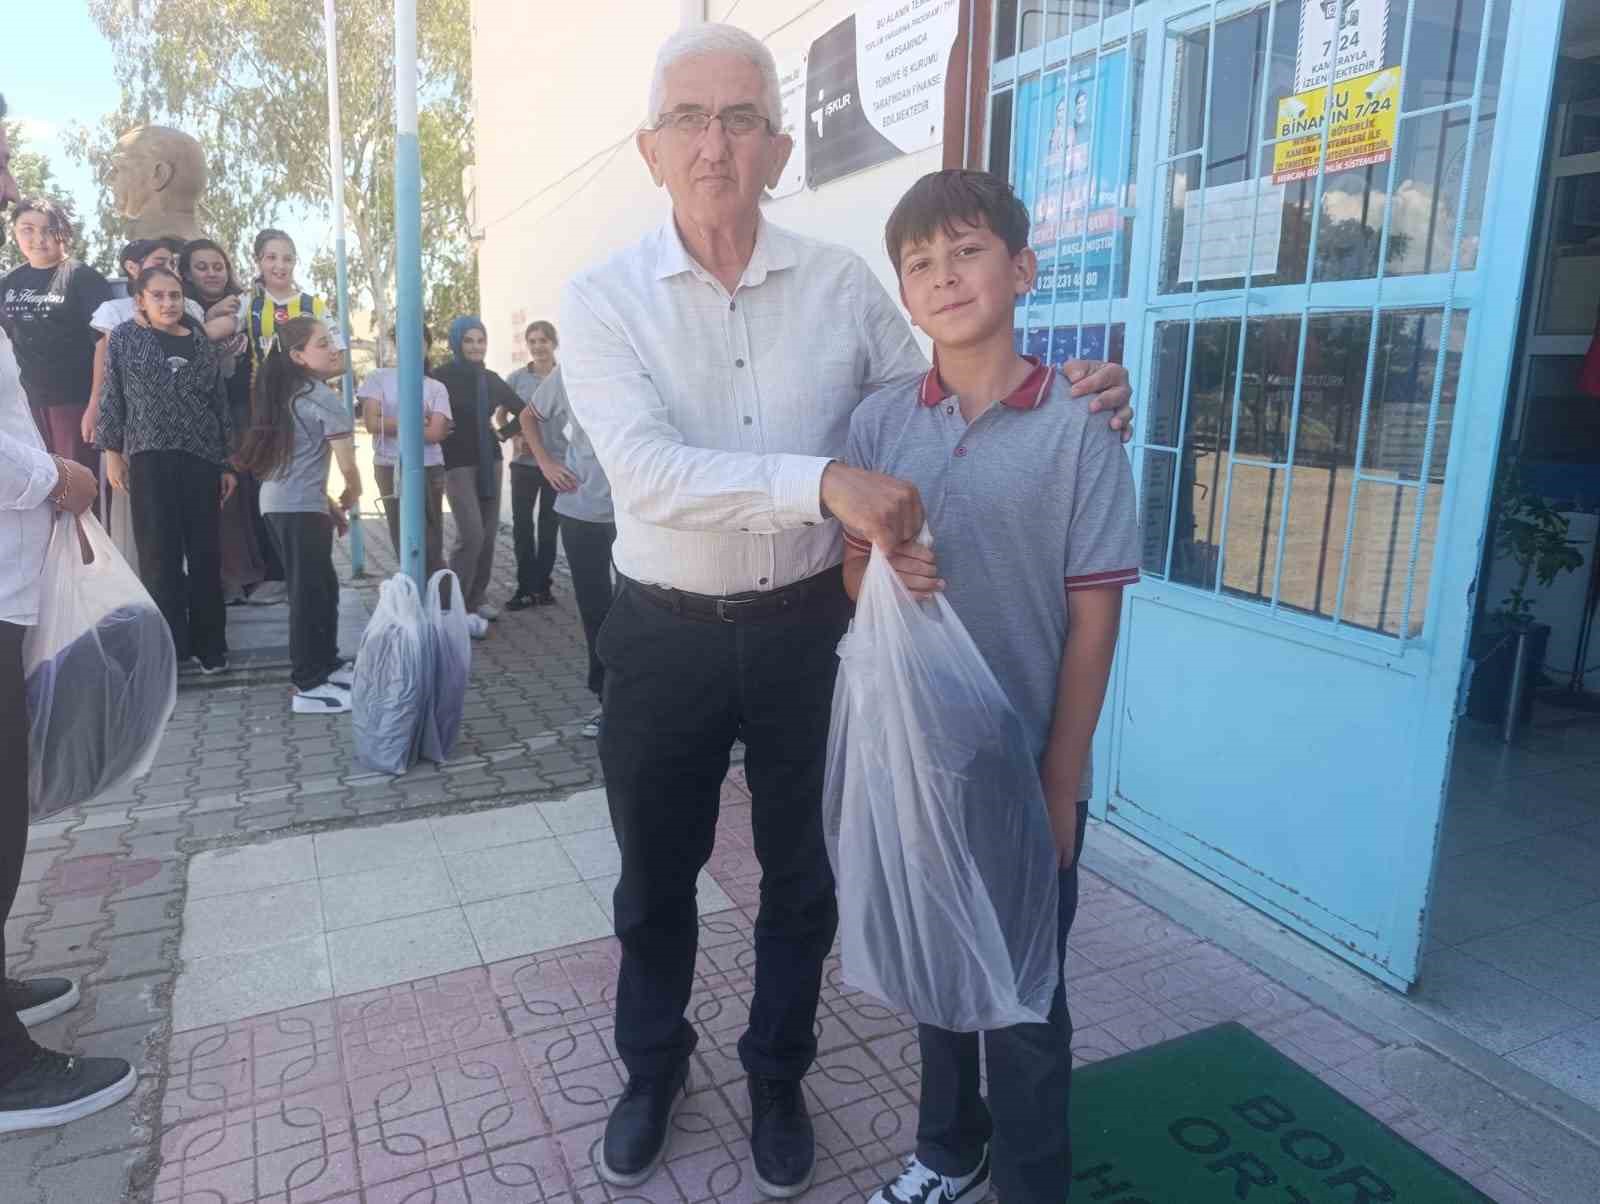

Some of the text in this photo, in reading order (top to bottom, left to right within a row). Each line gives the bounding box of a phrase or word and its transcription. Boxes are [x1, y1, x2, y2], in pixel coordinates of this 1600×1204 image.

[1322, 31, 1360, 57] 724
[1303, 60, 1376, 88] İZLENEKTEDİR
[1311, 50, 1367, 74] KAMRAYLA
[1354, 97, 1393, 119] 7/24
